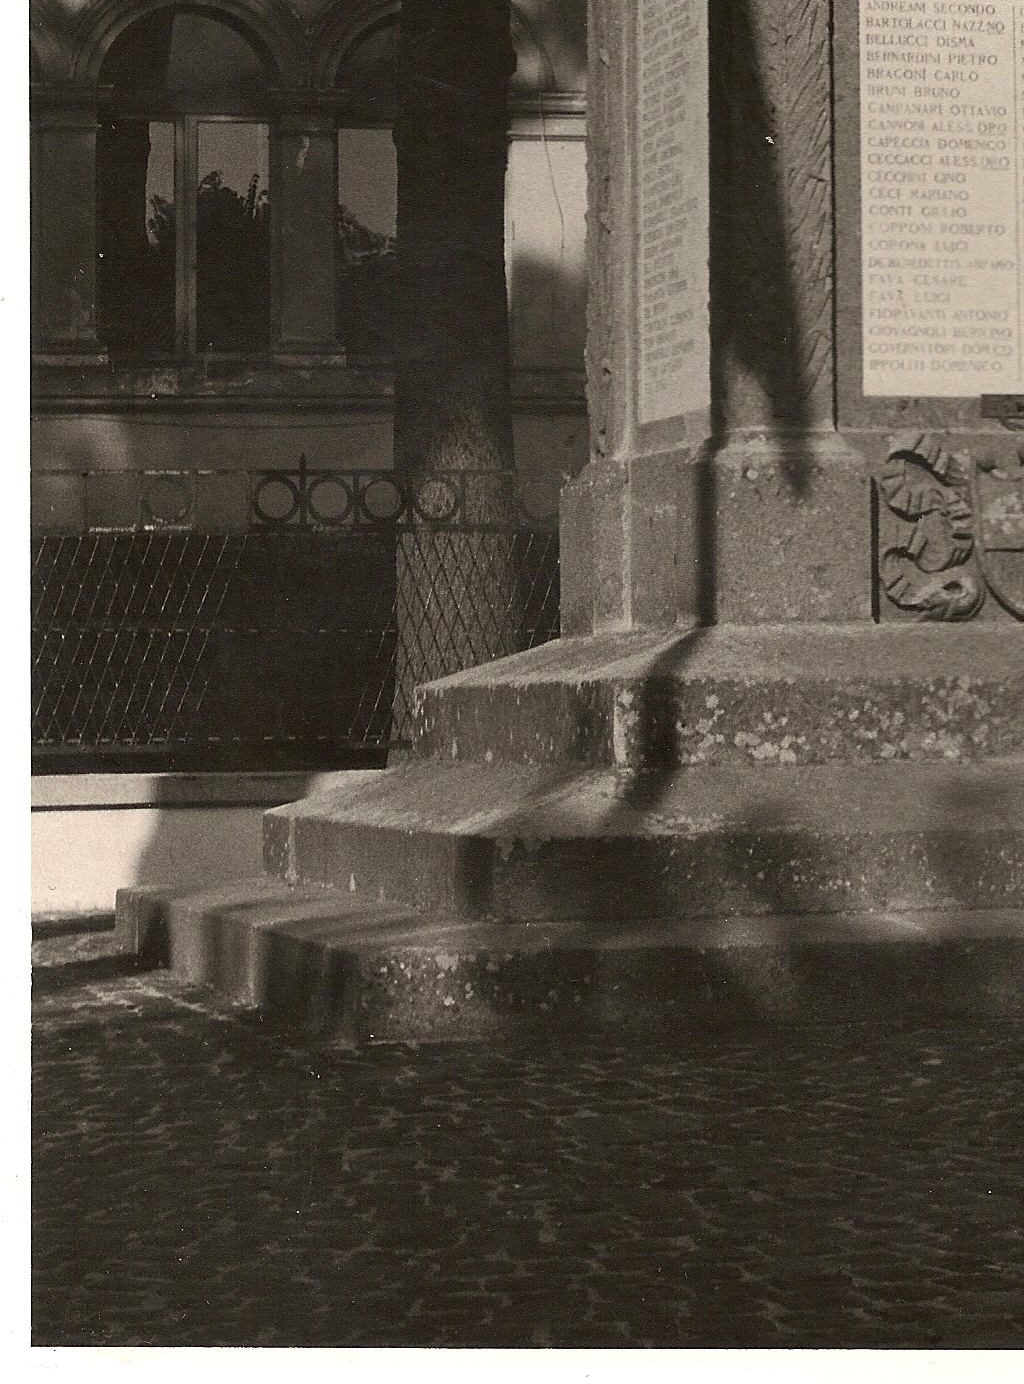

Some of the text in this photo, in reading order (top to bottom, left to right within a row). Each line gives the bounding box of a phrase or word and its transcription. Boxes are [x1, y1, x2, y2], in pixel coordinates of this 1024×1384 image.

[866, 1, 996, 16] ANDREANI SECONDO
[866, 16, 946, 30] BARTOLACCI
[866, 33, 975, 48] BELLUCCI DISMA
[866, 51, 998, 66] BERNARDINI PIETRO
[867, 68, 979, 82] BRACONI CARLO
[867, 85, 960, 97] BRUNI BRUNO
[950, 104, 1007, 116] OTTAVIO
[937, 138, 1006, 150] DOMENICO
[868, 154, 932, 165] CECCACCI
[934, 172, 966, 184] GINO
[869, 187, 969, 201] CECI MARIANO
[869, 205, 967, 218] CONTI GIULIO
[940, 223, 1005, 236] ROBERTO
[935, 240, 968, 253] LUIGI
[952, 310, 1008, 321] ANTONIO
